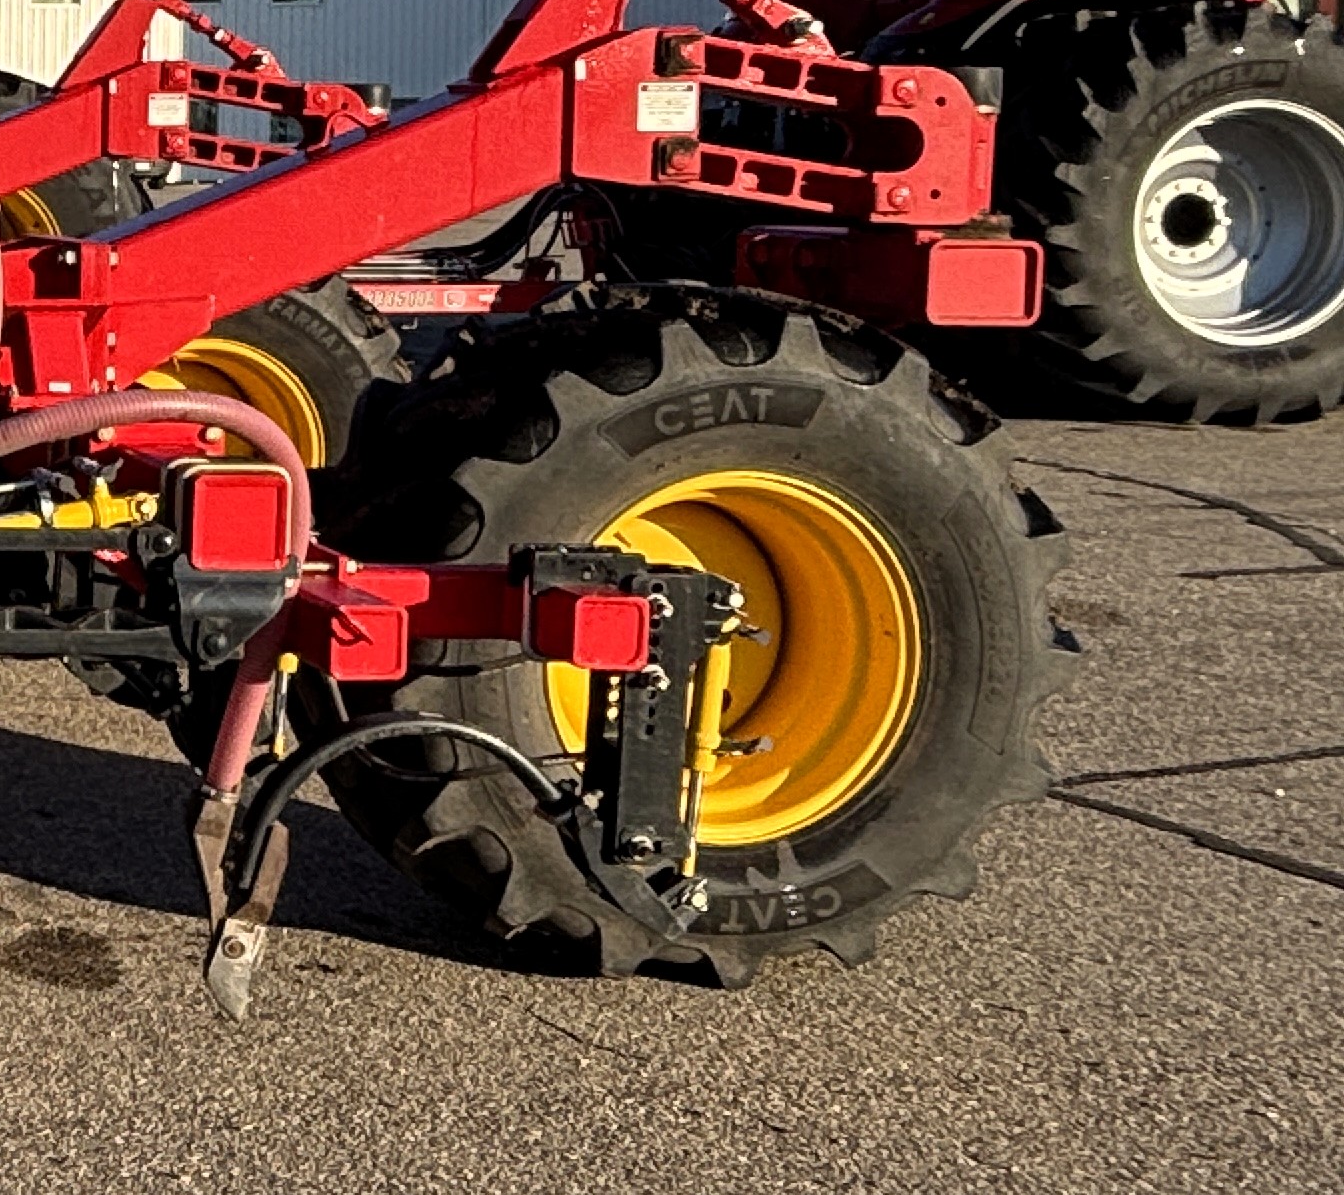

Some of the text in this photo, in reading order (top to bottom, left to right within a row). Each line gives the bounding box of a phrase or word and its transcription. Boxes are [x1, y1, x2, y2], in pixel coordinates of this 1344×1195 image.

[1146, 61, 1287, 136] MICHELIN
[268, 297, 353, 357] FARMAX
[654, 387, 775, 436] CEAT
[719, 884, 842, 933] CEAT
